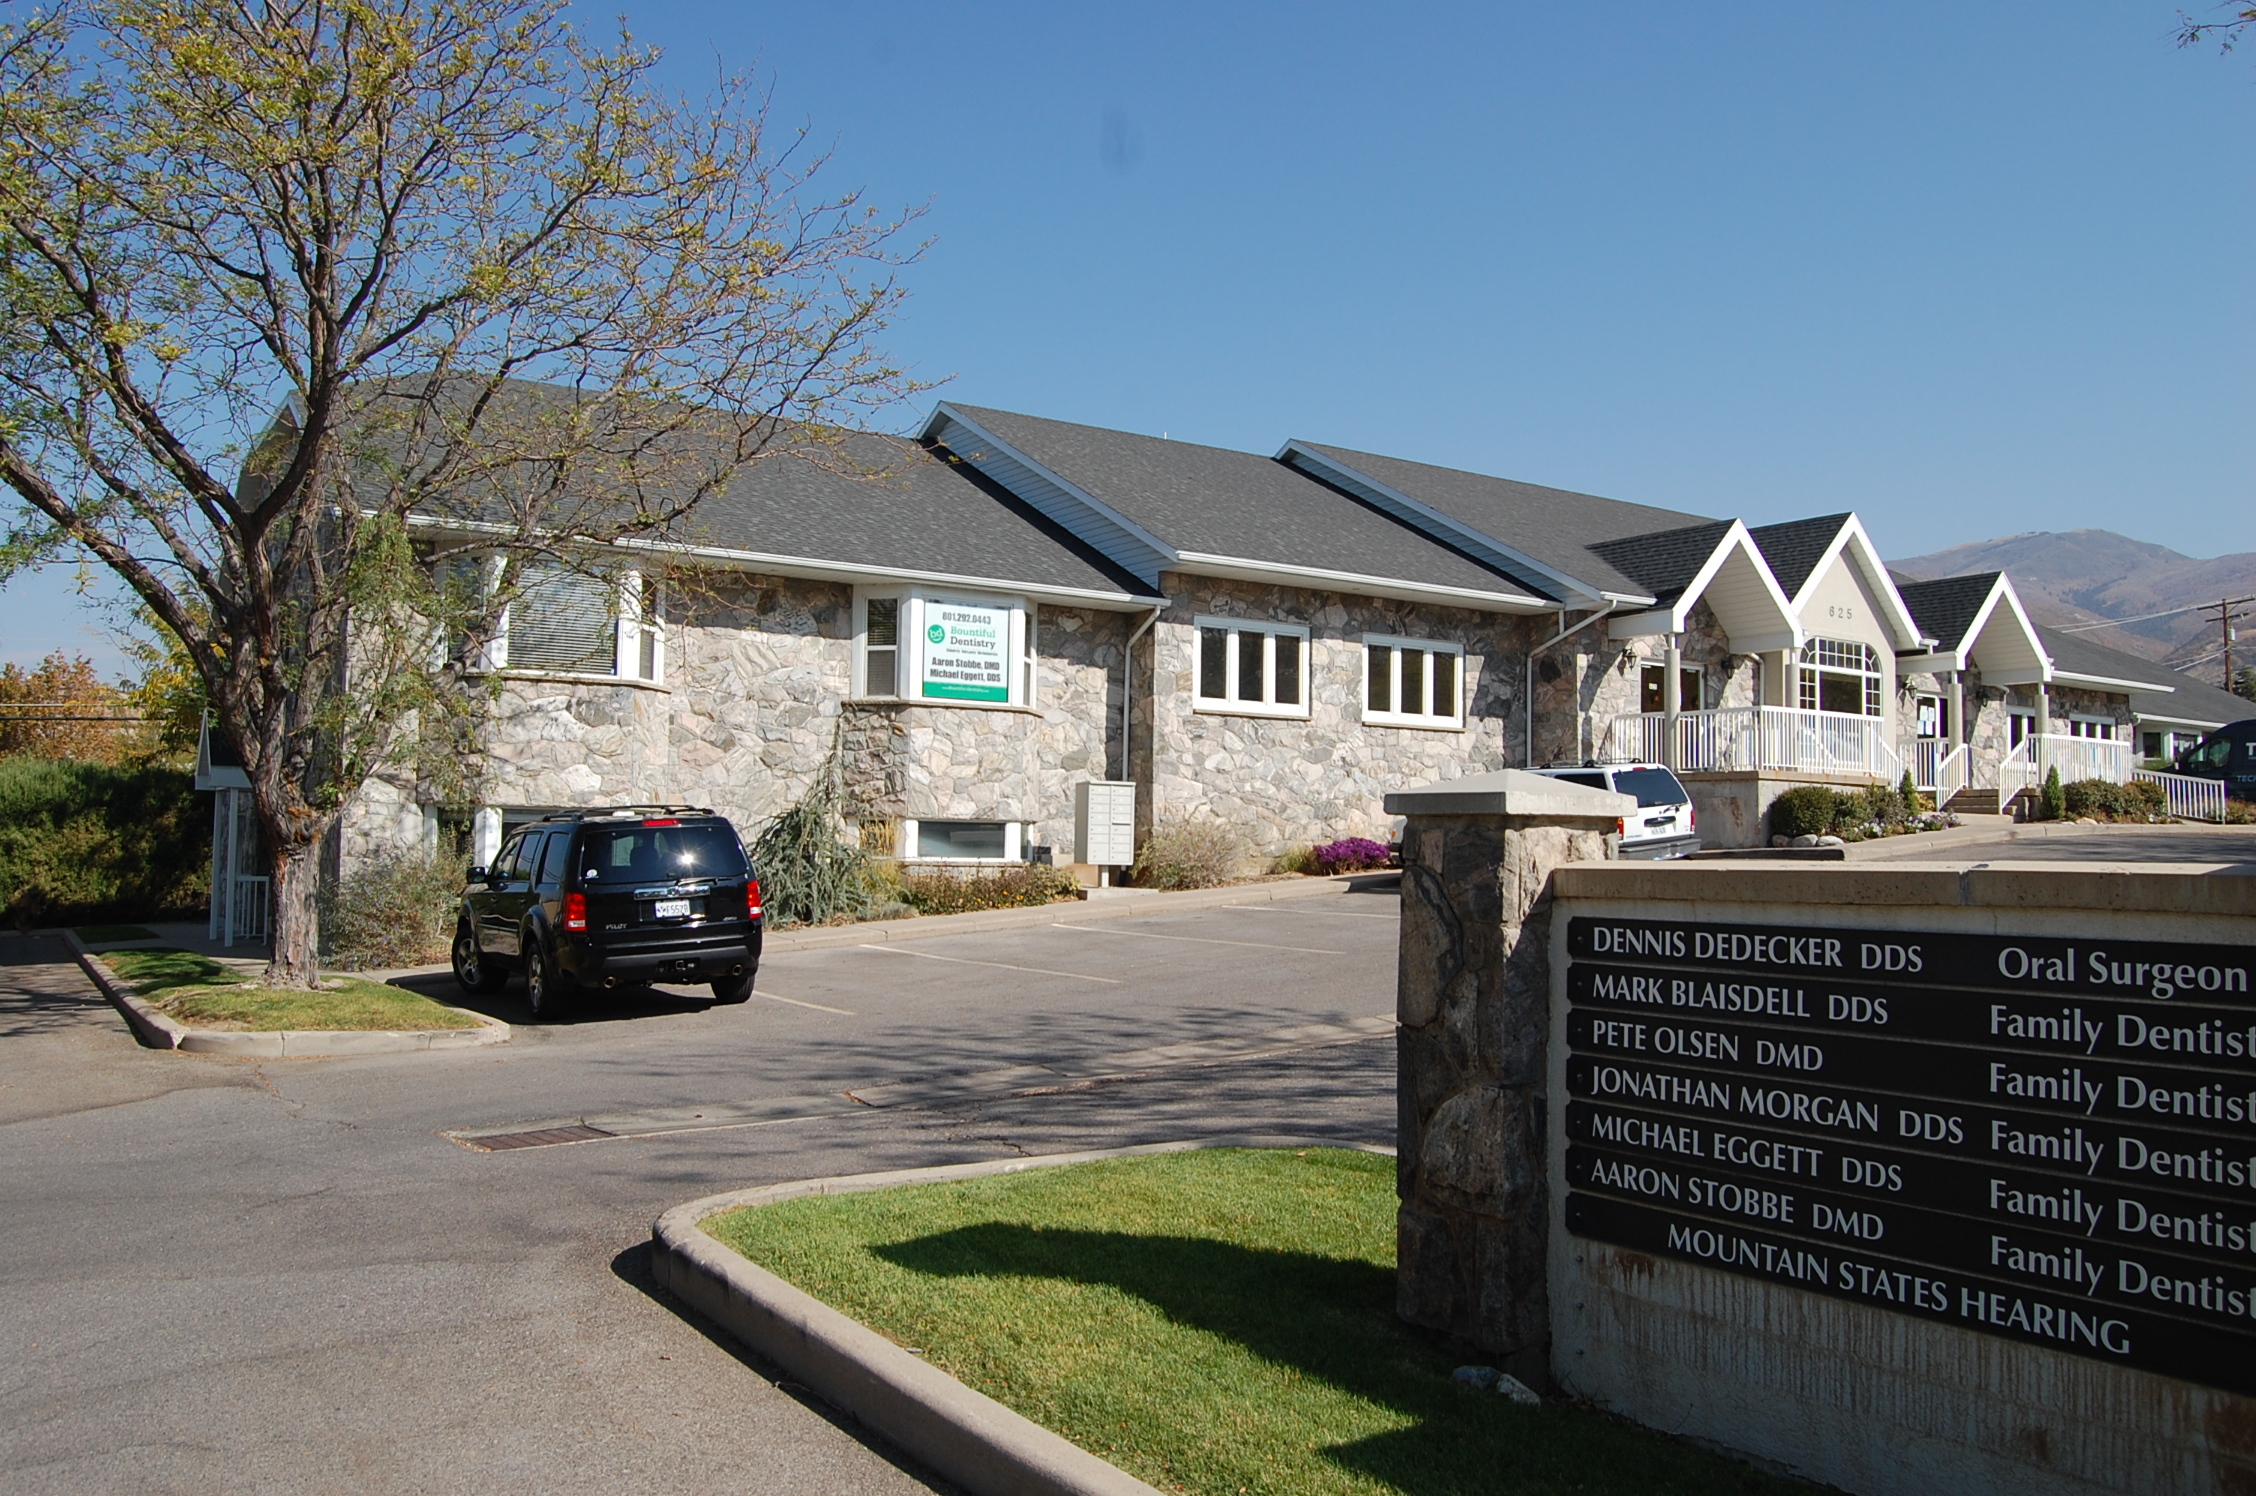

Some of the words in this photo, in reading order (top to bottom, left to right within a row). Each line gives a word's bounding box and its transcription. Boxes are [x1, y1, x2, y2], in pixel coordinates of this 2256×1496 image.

[943, 612, 991, 624] 801.292.0443
[950, 626, 996, 638] Bountiful
[1829, 605, 1852, 620] 625
[932, 657, 954, 667] Aaron
[955, 658, 983, 670] Stobbe,
[984, 661, 1000, 671] DMD
[950, 636, 996, 650] Dentistry
[930, 668, 959, 679] Michael
[960, 670, 985, 682] Eggett,
[986, 673, 1001, 682] DDS
[1593, 926, 1686, 958] DENNIS
[1694, 932, 1843, 967] DEDECKER
[1860, 943, 1923, 973] DDS
[1998, 947, 2075, 982] Oral
[2088, 951, 2248, 1000] Surgeon
[1592, 973, 1664, 1004] MARK
[1671, 979, 1811, 1018] BLAISDELL
[1828, 994, 1888, 1025] DDS
[1593, 1019, 1647, 1051] PETE
[1654, 1026, 1739, 1062] OLSEN
[1756, 1040, 1823, 1071] DMD
[1990, 1004, 2104, 1055] Family
[2117, 1014, 2256, 1059] Dentist
[1590, 1065, 1730, 1111] JONATHAN
[1739, 1086, 1878, 1132] MORGAN
[1899, 1109, 1964, 1144] DDS
[1989, 1062, 2104, 1116] Family
[2117, 1075, 2256, 1124] Dentist
[1592, 1113, 1705, 1157] MICHAEL
[1713, 1132, 1824, 1177] EGGETT
[1842, 1156, 1903, 1192] DDS
[1991, 1119, 2104, 1176] Family
[1590, 1158, 1679, 1200] AARON
[1688, 1177, 1794, 1224] STOBBE
[1812, 1203, 1884, 1240] DMD
[1990, 1178, 2104, 1237] Family
[1668, 1223, 1828, 1285] MOUNTAIN
[1839, 1261, 1948, 1312] STATES
[1960, 1287, 2130, 1354] HEARING
[1991, 1235, 2105, 1297] Family
